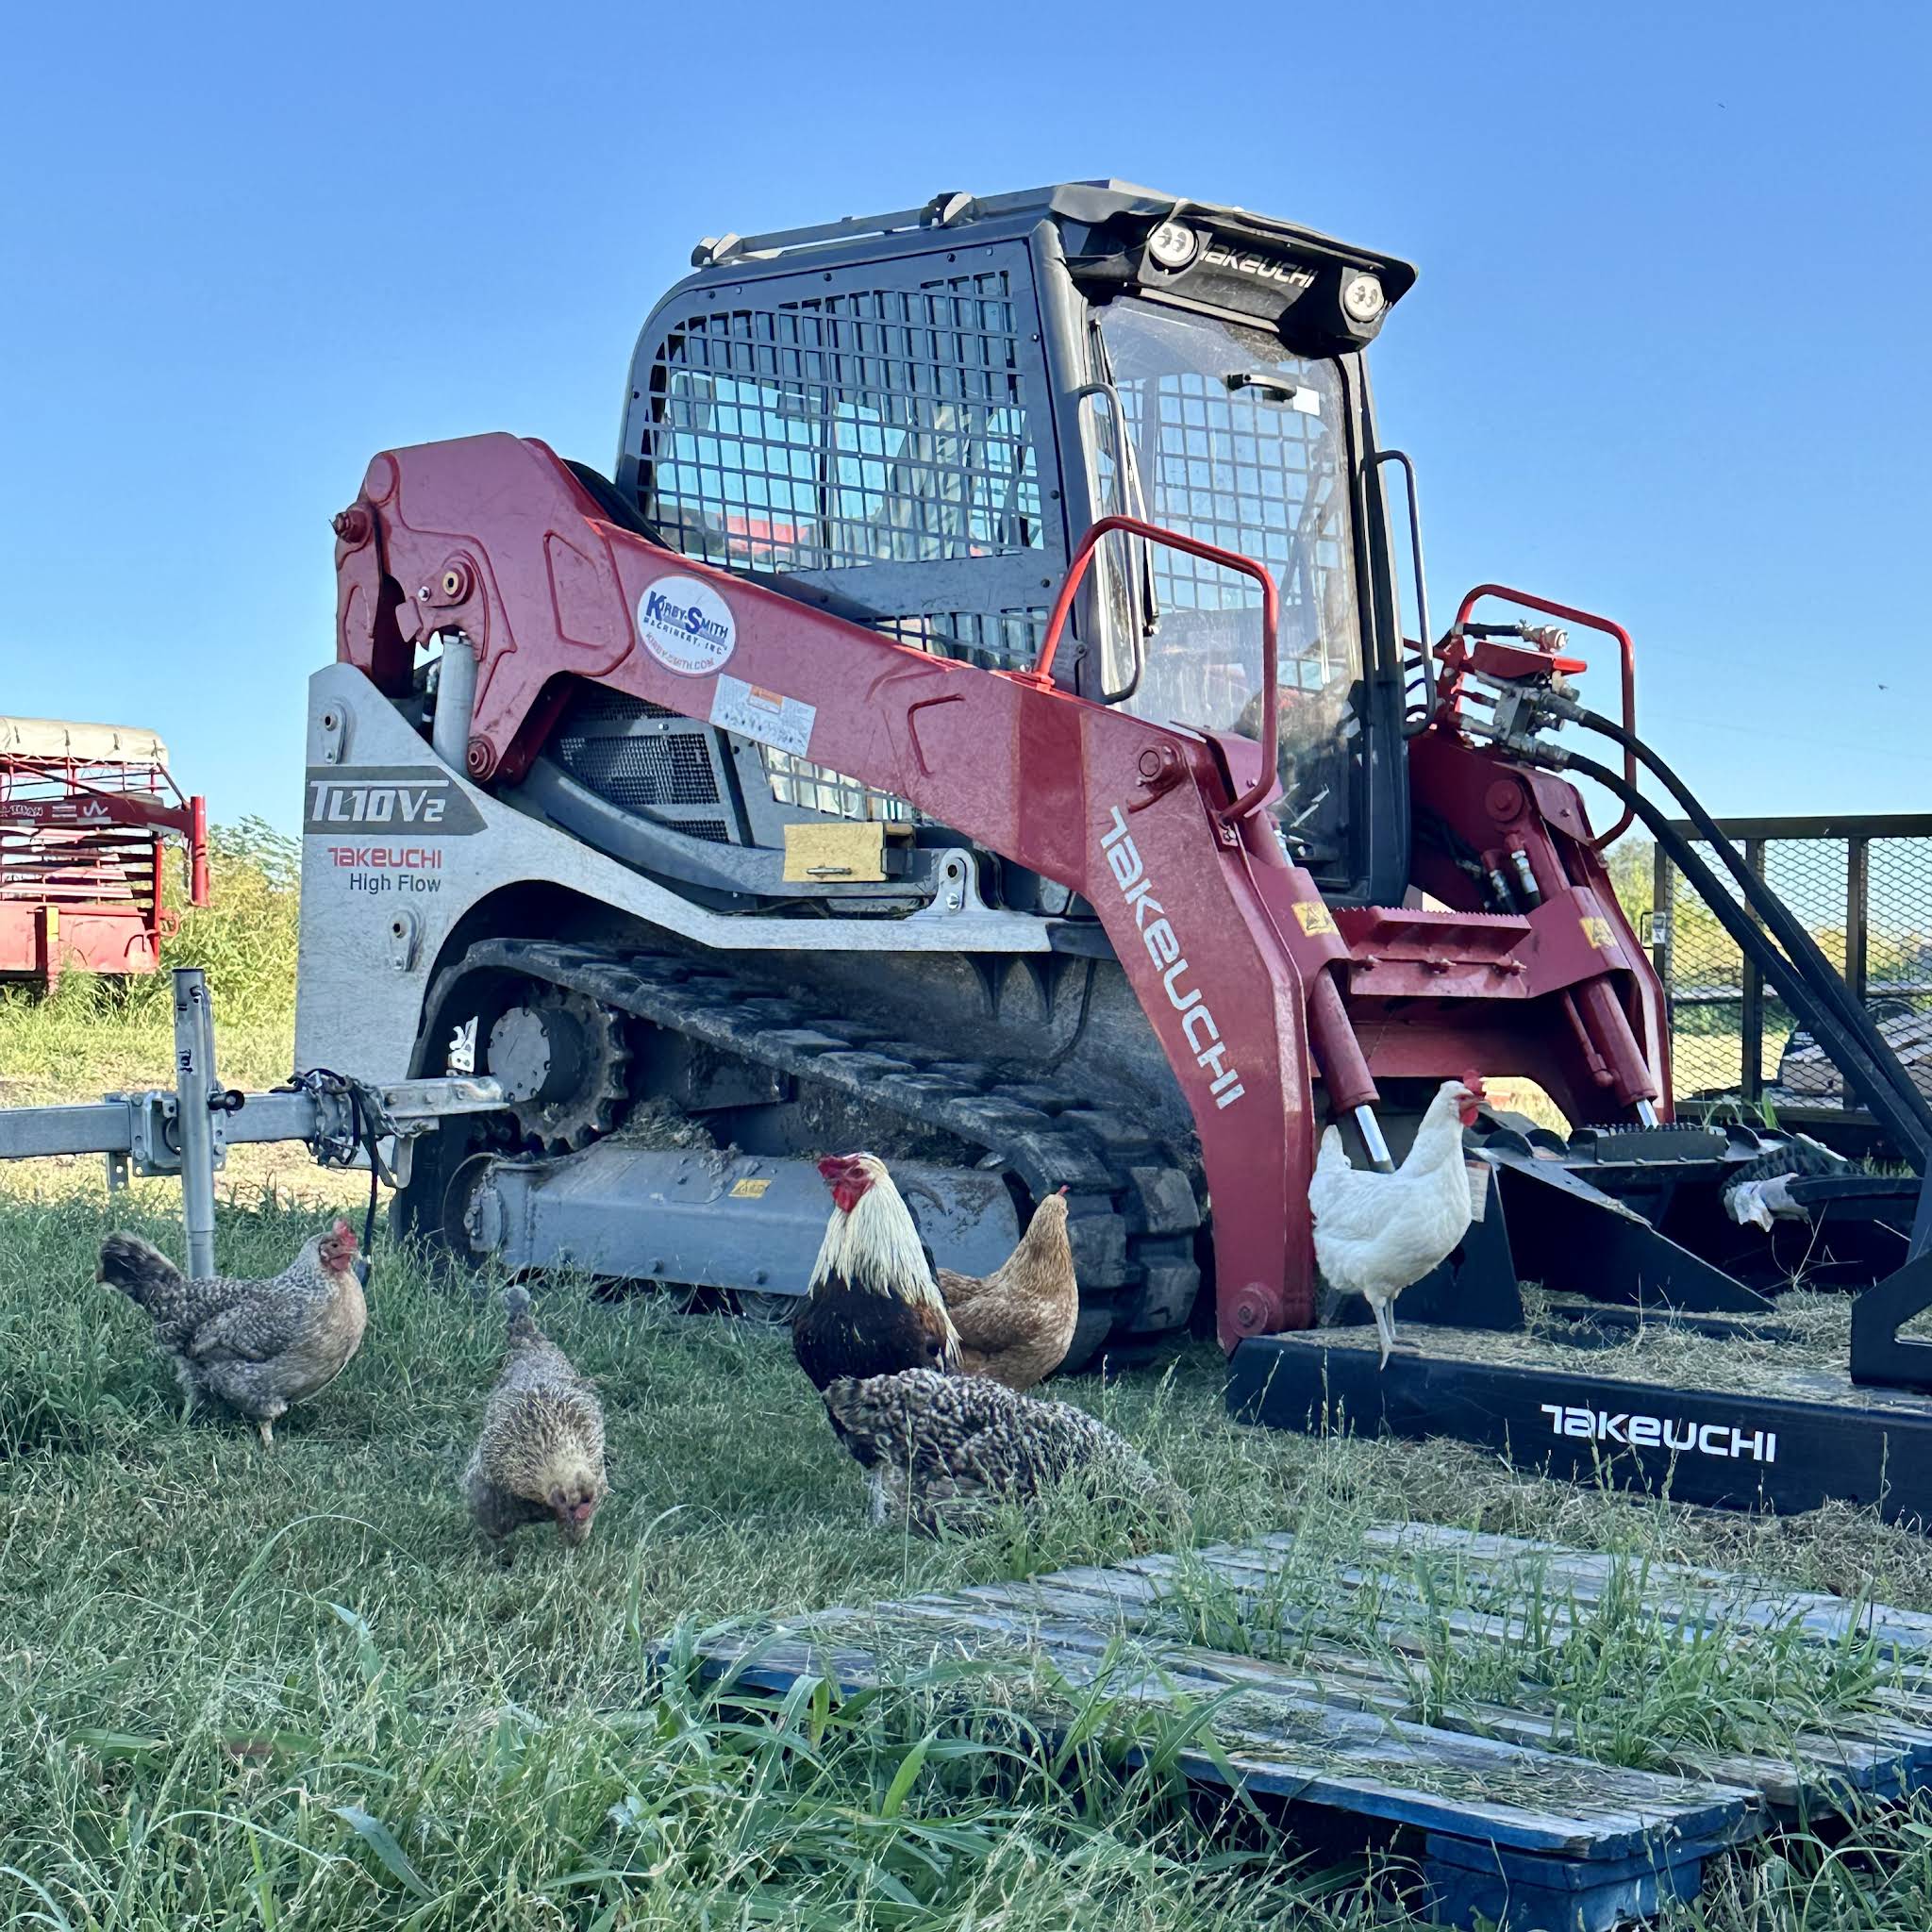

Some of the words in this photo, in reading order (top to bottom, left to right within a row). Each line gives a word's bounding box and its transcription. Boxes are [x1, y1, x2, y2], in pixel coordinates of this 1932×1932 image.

[309, 779, 449, 823] TL10V2
[350, 873, 391, 894] High
[398, 874, 441, 892] Flow
